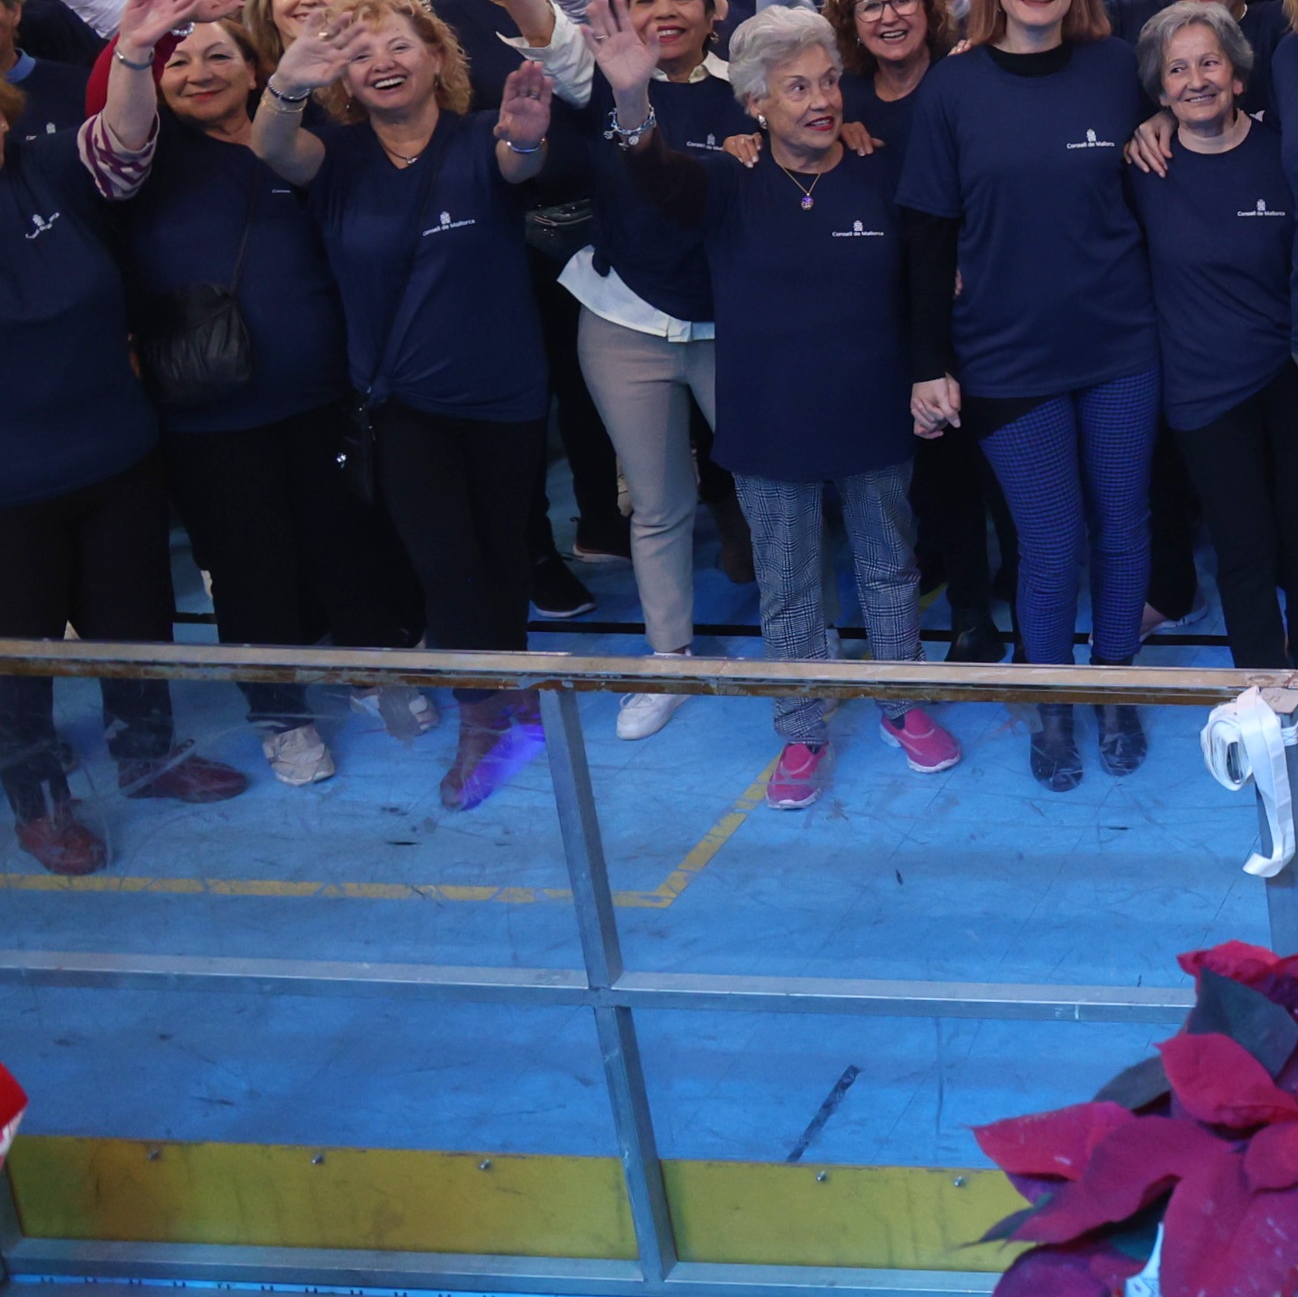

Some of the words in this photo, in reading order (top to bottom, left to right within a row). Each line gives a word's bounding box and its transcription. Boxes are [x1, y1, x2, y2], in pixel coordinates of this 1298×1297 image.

[1237, 210, 1256, 218] Consell
[449, 218, 476, 229] Mallorca
[832, 230, 853, 238] Consell
[862, 229, 885, 237] Mallorca
